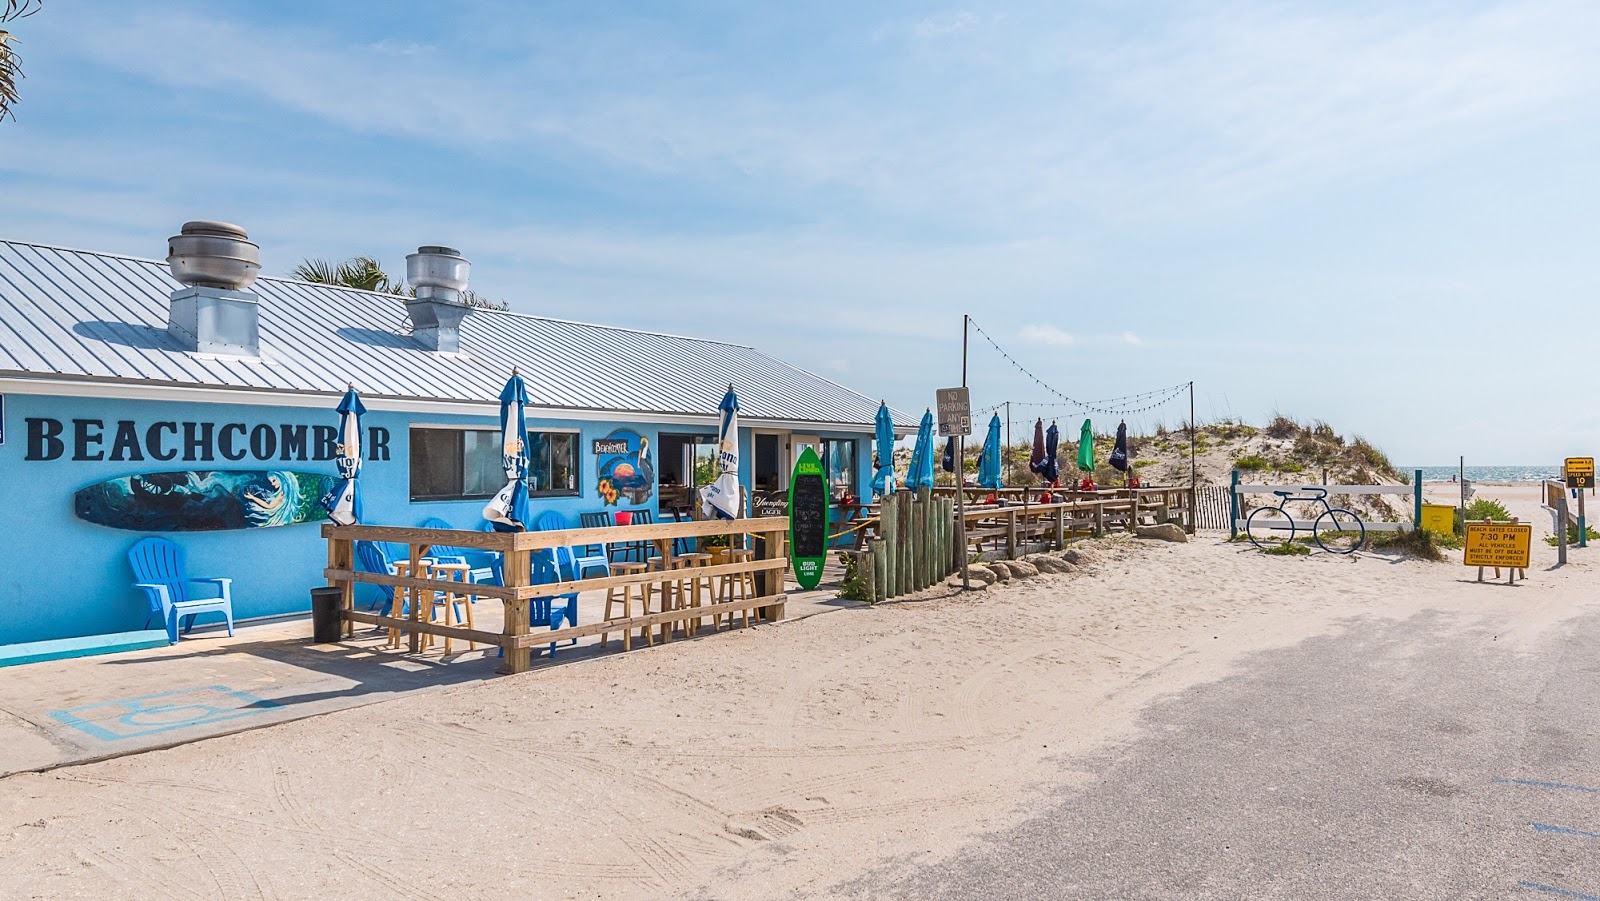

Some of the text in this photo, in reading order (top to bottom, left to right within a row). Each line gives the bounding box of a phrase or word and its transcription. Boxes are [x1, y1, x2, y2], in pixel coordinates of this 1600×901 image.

[947, 391, 958, 401] NO
[939, 401, 968, 412] PARKING
[946, 413, 961, 423] ANY
[24, 417, 391, 461] BEACHCOMBR
[753, 496, 789, 508] Yuengling
